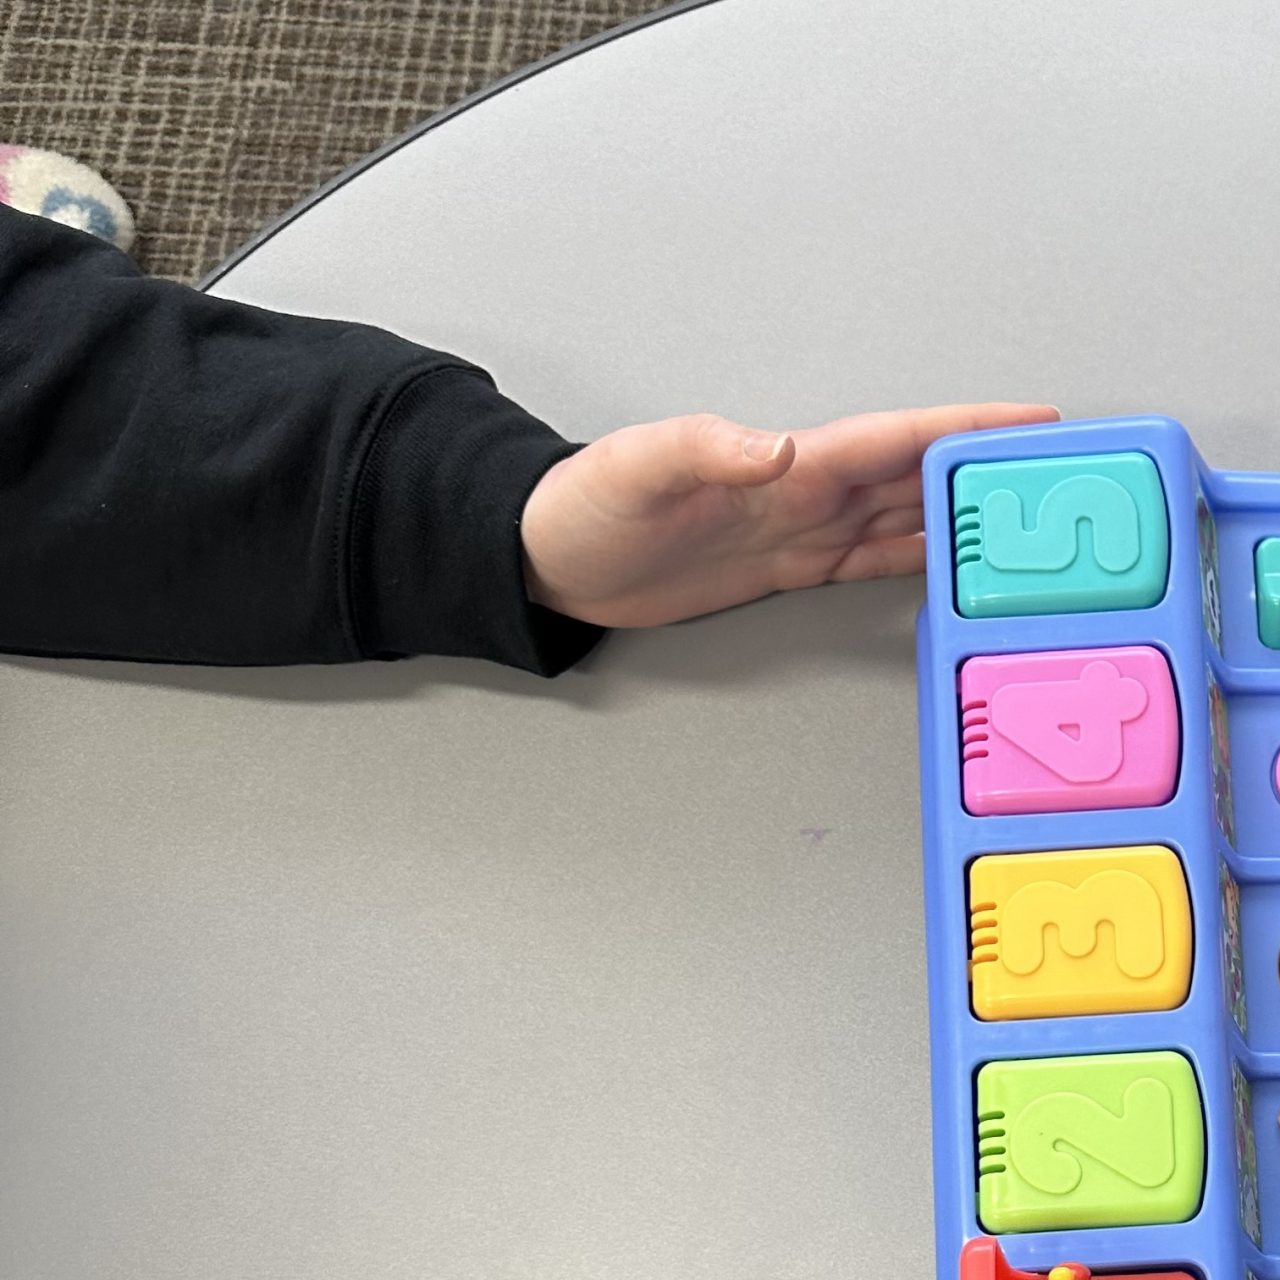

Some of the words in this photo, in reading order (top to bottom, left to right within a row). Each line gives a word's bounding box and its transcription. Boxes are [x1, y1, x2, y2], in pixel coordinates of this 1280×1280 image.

[982, 474, 1142, 574] 5
[991, 660, 1149, 783] 4
[1001, 869, 1166, 979] 3
[1009, 1077, 1175, 1195] 2
